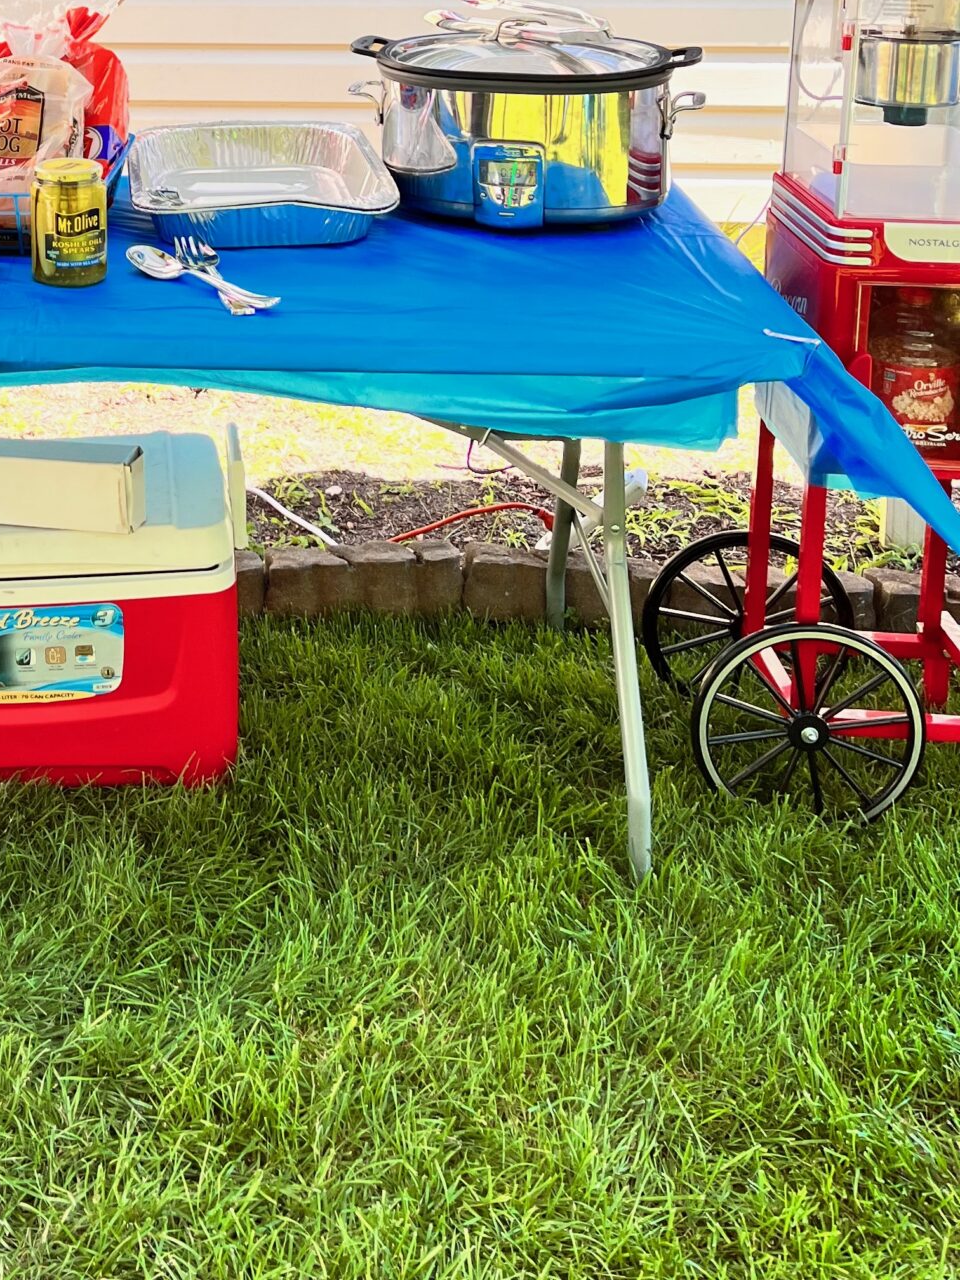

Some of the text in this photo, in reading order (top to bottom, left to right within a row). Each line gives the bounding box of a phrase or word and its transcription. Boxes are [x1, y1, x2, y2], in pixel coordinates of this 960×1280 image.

[57, 214, 99, 233] Mt. Olive
[908, 238, 960, 248] NOSTALG
[62, 246, 95, 255] SPEARS
[914, 378, 946, 391] Orville
[13, 608, 80, 630] Breeze
[23, 630, 82, 642] Family Cooler
[44, 692, 75, 700] CAPACITY
